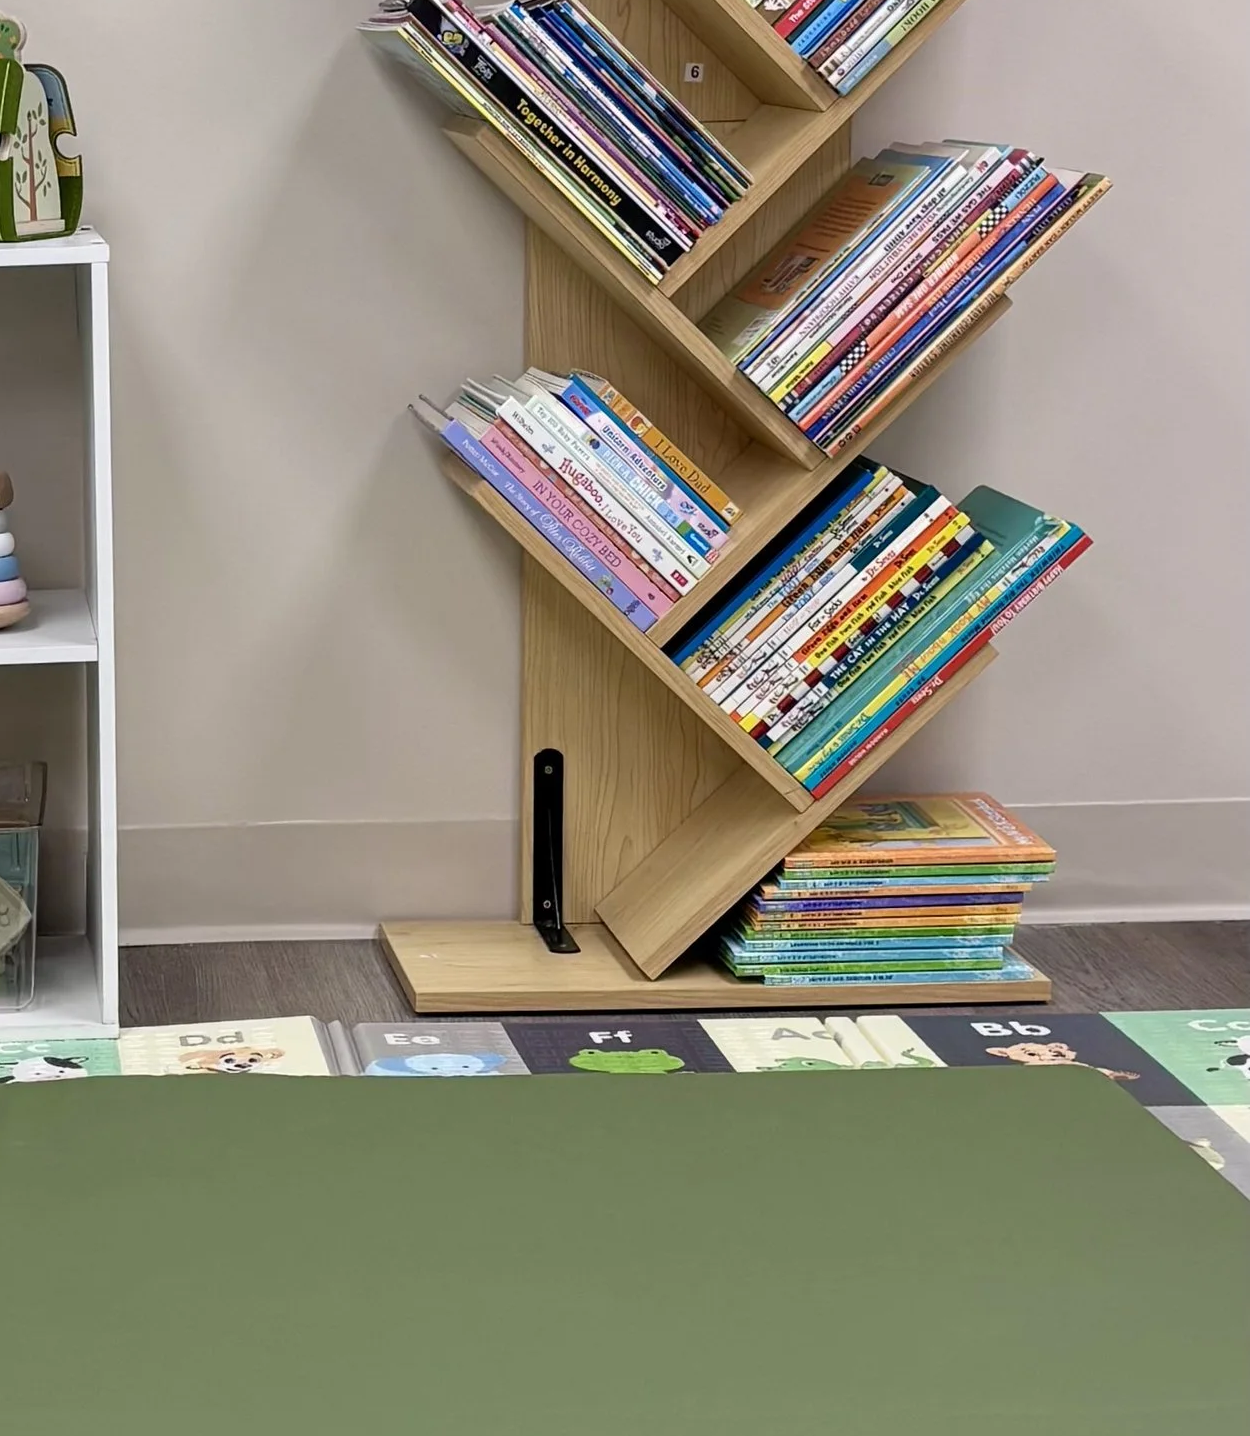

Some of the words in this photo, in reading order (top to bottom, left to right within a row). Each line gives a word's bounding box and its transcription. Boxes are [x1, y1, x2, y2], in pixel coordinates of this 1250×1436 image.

[787, 6, 805, 24] The
[690, 65, 700, 80] 6
[512, 96, 564, 149] Together
[557, 142, 578, 163] in
[568, 154, 623, 209] Harmony
[975, 182, 992, 199] THE
[960, 196, 978, 214] GAS
[903, 212, 922, 231] have
[929, 222, 951, 244] PASS
[907, 282, 927, 302] ONE
[890, 297, 912, 319] SAM
[657, 442, 688, 477] Love
[687, 469, 712, 494] Dad
[531, 479, 546, 495] IN
[542, 490, 574, 522] YOUR
[569, 517, 602, 549] COZY
[596, 543, 623, 569] BED
[624, 524, 644, 543] You
[1040, 563, 1064, 586] HAPPY
[780, 579, 810, 610] Green
[822, 597, 844, 619] Socks
[828, 660, 850, 681] THE
[846, 645, 866, 664] CAT
[874, 619, 893, 638] THE
[890, 601, 912, 623] HAT
[178, 1030, 245, 1047] Dd
[383, 1031, 441, 1047] Ee
[588, 1029, 633, 1045] Ff
[970, 1021, 1051, 1038] Bb
